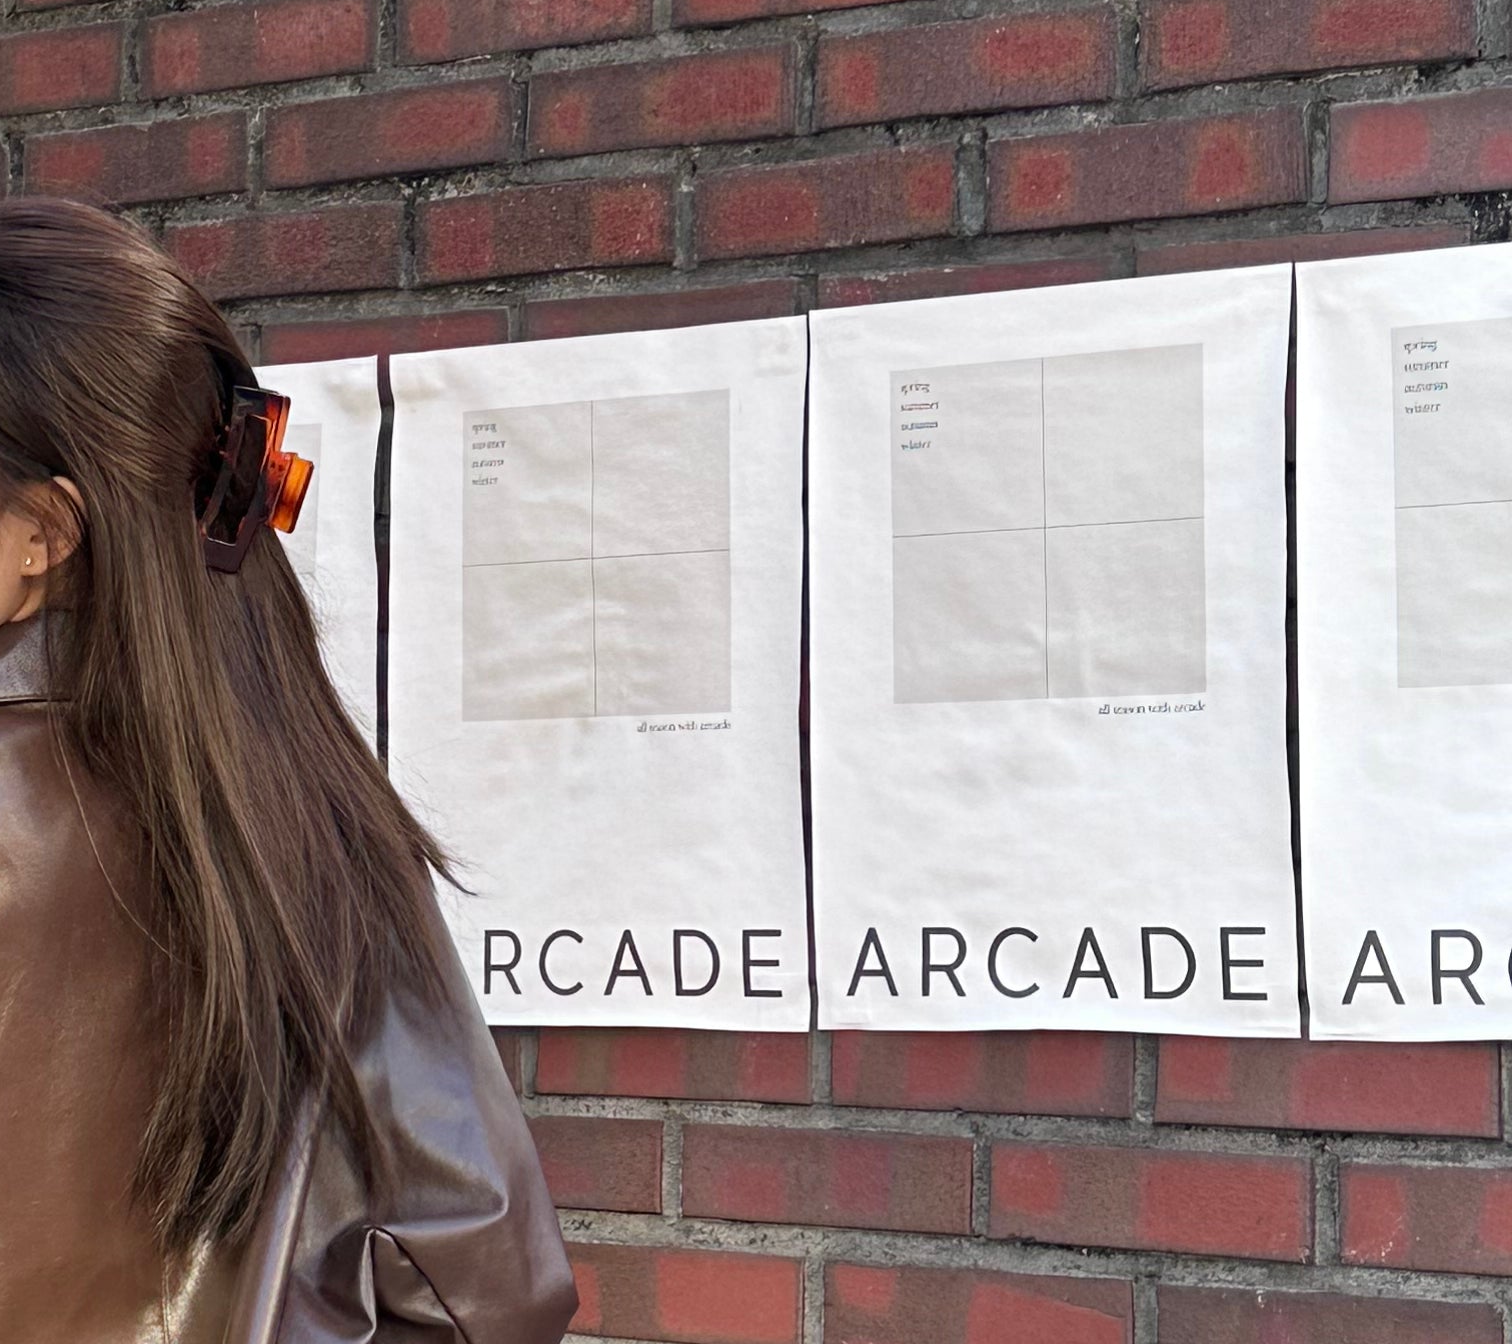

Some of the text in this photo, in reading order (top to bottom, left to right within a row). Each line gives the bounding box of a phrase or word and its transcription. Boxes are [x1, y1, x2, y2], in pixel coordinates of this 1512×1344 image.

[483, 929, 784, 998] RCADE
[846, 926, 1268, 1001] ARCADE
[1341, 928, 1512, 1006] AR
